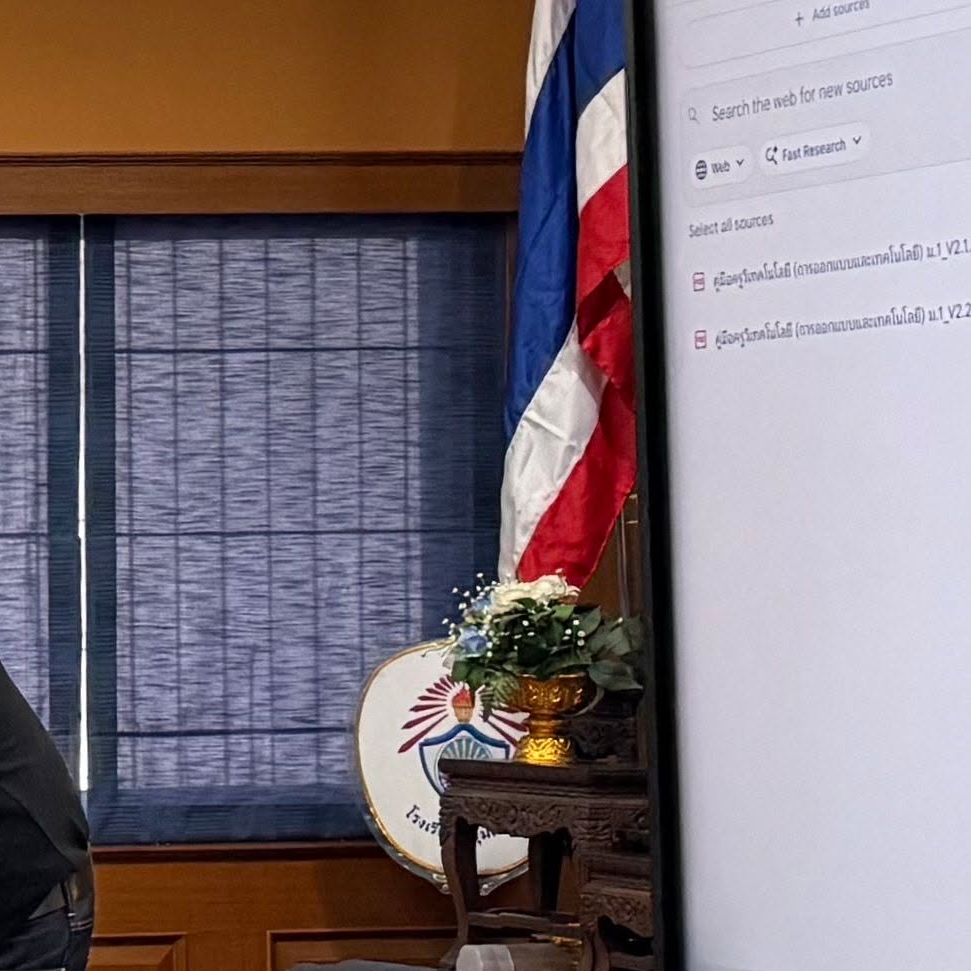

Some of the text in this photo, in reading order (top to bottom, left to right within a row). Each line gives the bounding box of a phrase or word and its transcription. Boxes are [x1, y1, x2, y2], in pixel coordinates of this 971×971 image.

[812, 0, 870, 21] Add sources
[712, 72, 894, 122] Search the web for new sources
[782, 138, 847, 162] Fast Research
[711, 159, 731, 174] Web
[689, 214, 774, 238] Select all sources
